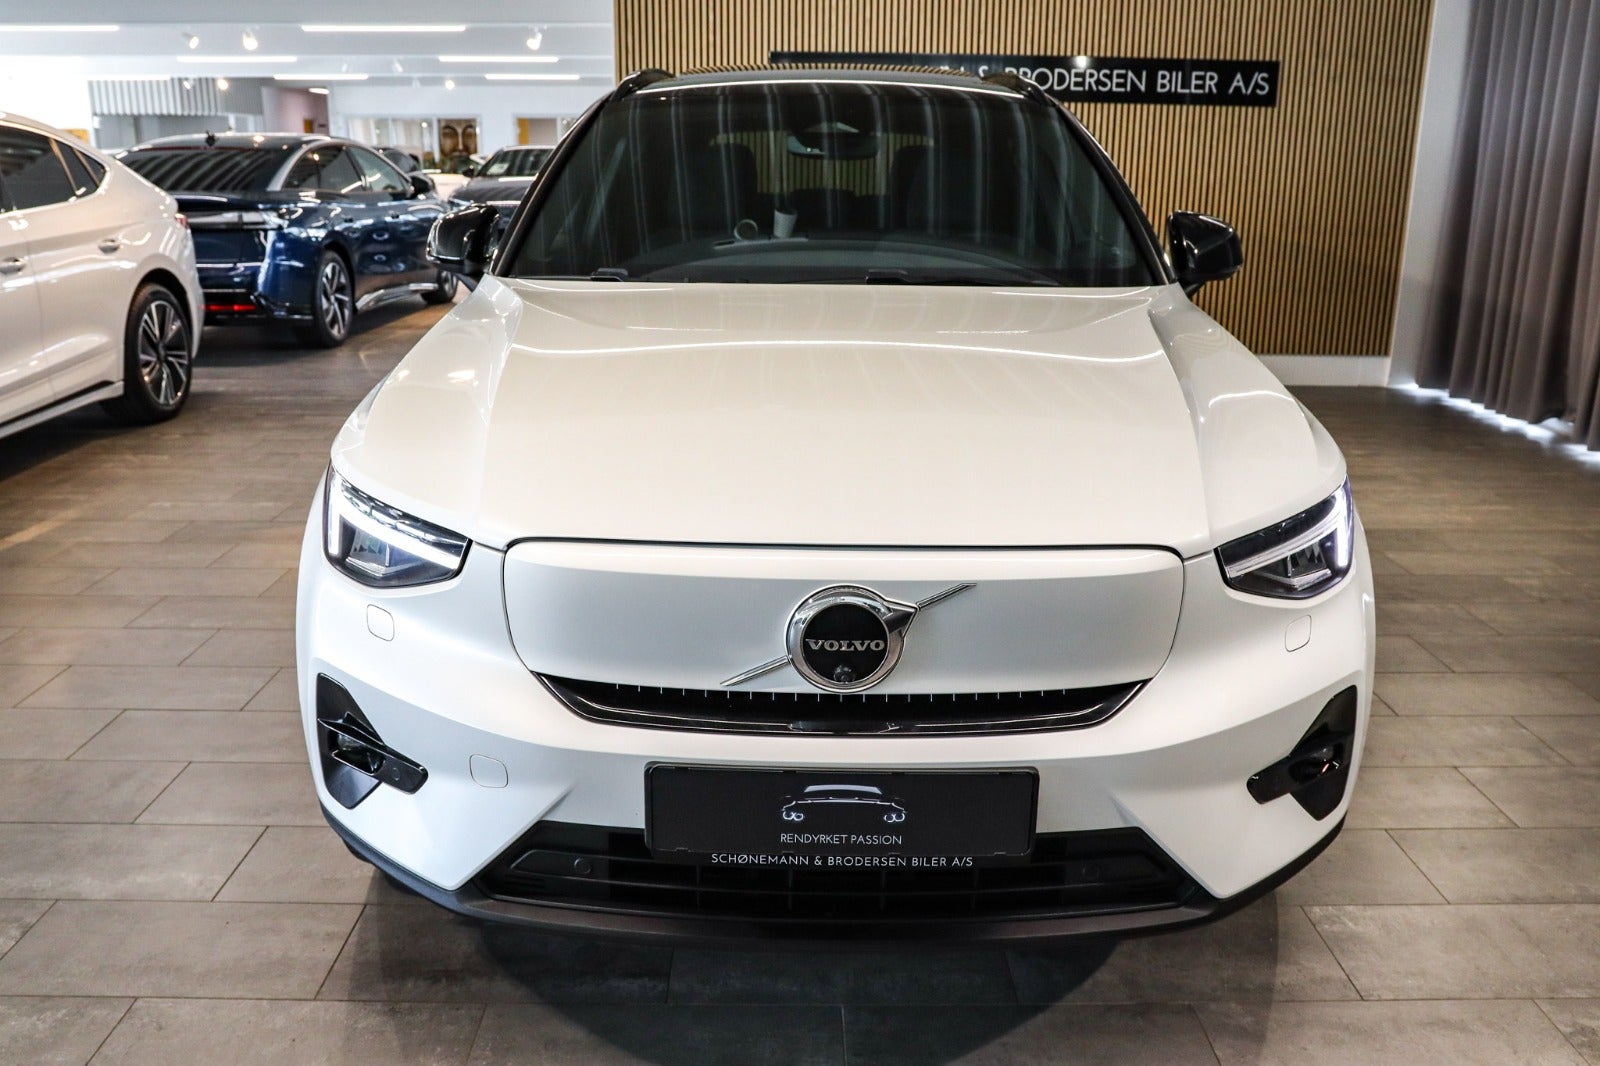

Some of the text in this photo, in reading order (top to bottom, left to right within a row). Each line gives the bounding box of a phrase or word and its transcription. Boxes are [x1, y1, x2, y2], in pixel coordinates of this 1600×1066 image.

[1156, 70, 1219, 94] BILER
[1228, 71, 1270, 96] A/S
[805, 638, 885, 652] VOLVO
[780, 833, 902, 845] RENDYRKET PASSION
[711, 853, 973, 867] SCHØNEMANN & BRODERSEN BILER A/S
